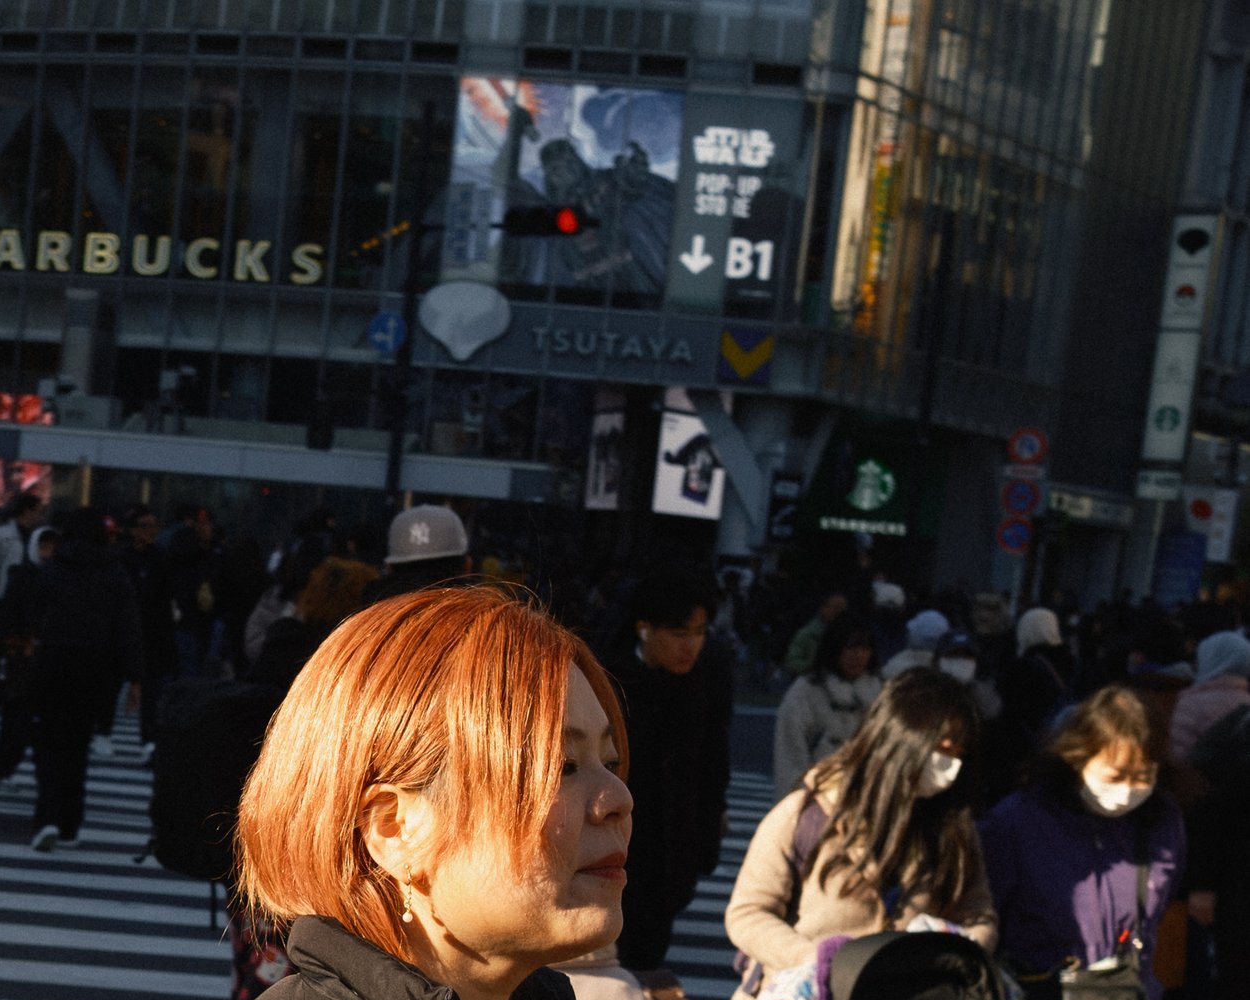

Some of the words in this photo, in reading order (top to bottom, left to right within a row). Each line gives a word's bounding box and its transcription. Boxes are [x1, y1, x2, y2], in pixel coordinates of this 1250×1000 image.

[724, 236, 776, 281] B1
[532, 326, 693, 362] TSUTAYA
[819, 515, 907, 537] STARBUCKS
